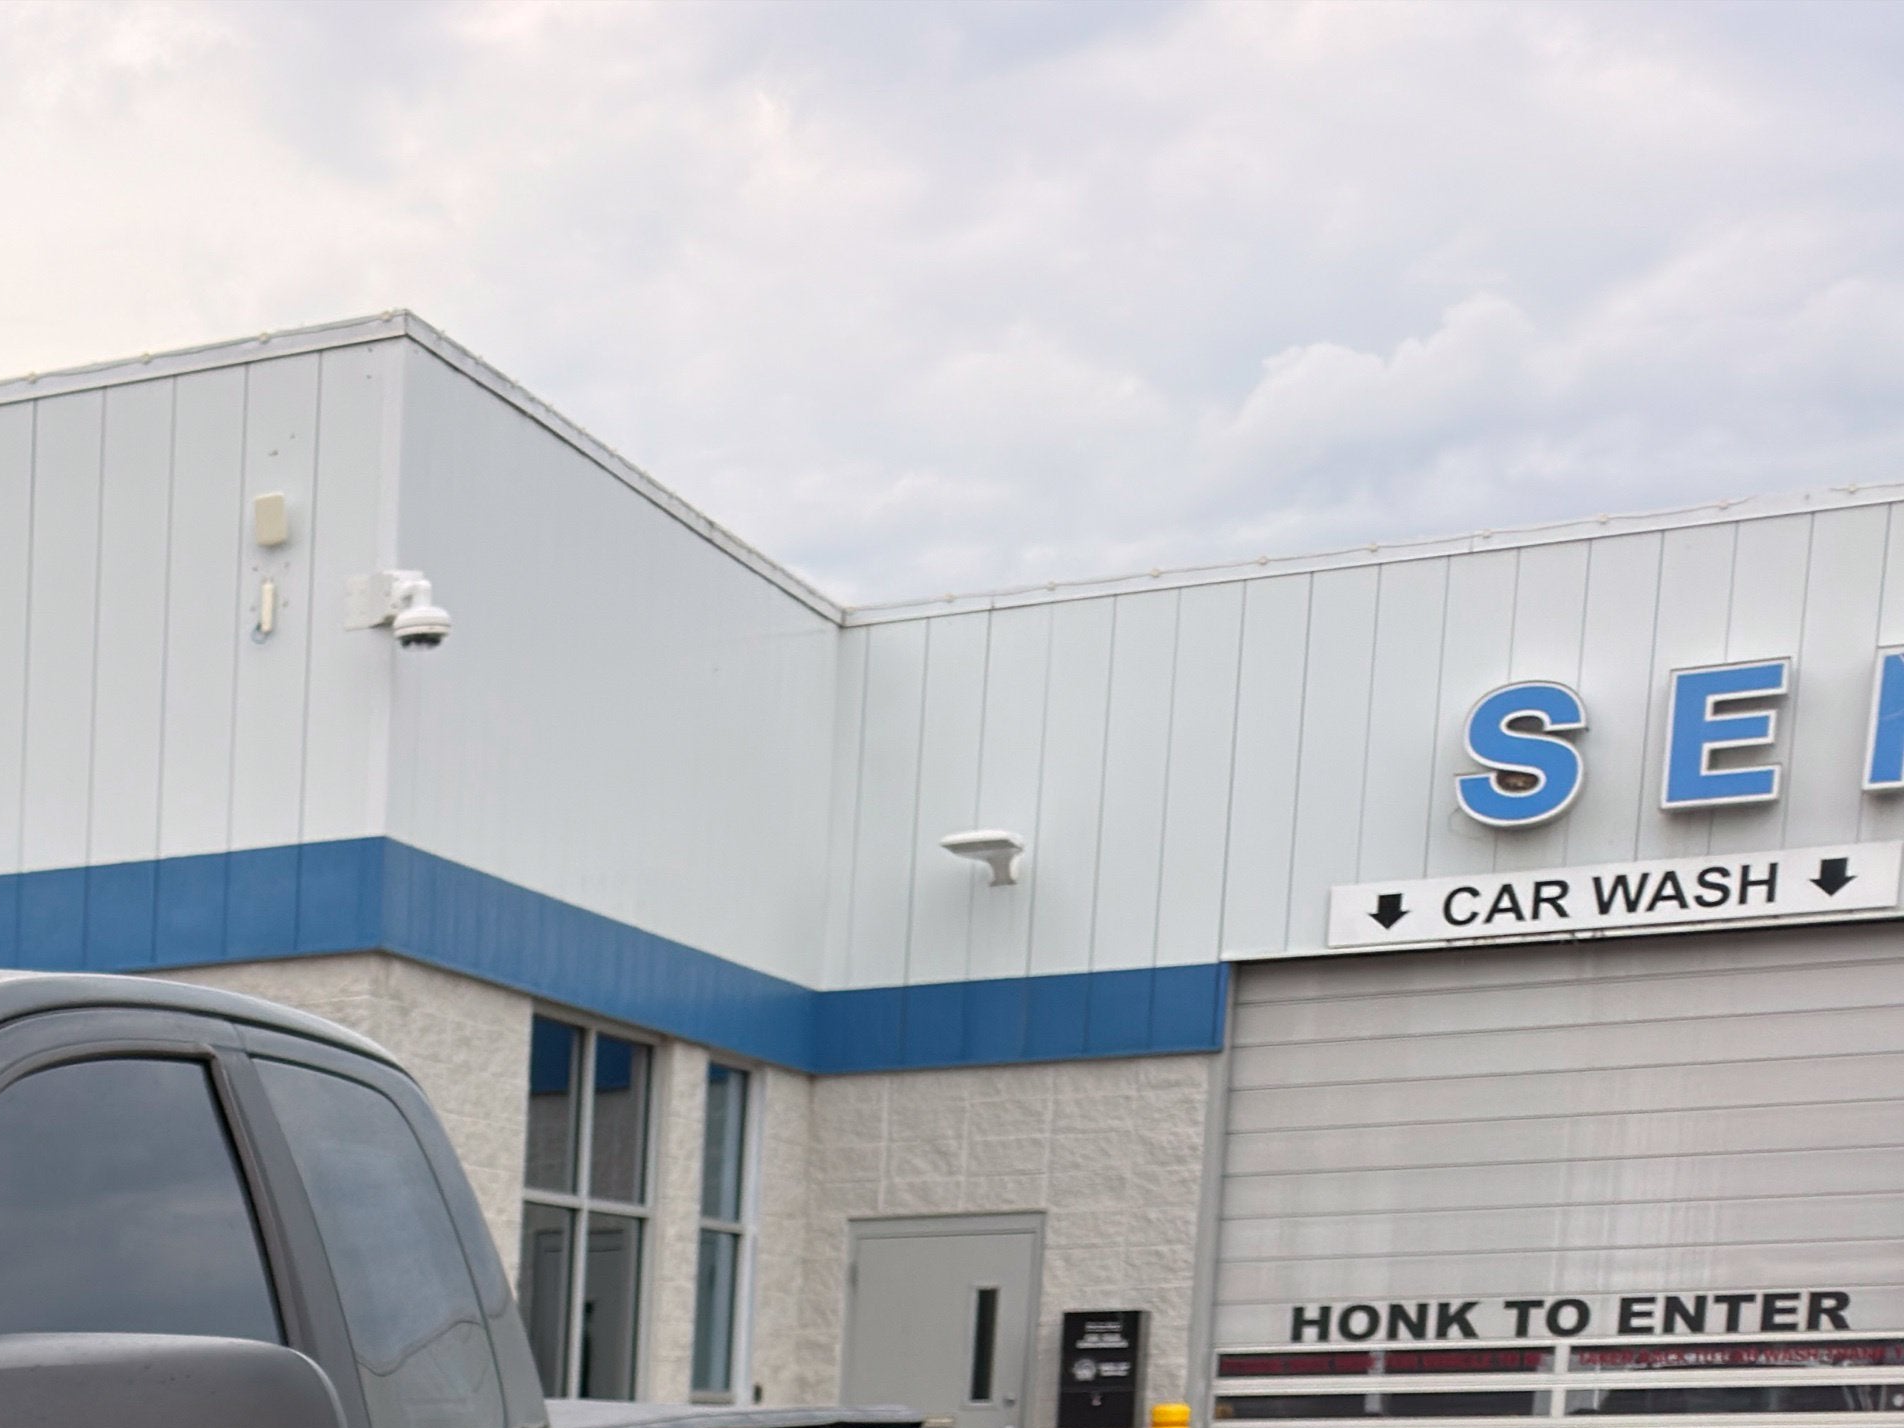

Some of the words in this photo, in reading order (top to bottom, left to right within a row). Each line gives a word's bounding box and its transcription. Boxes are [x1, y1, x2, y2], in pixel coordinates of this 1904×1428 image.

[1442, 878, 1570, 927] CAR
[1593, 862, 1778, 915] WASH
[1289, 1301, 1479, 1343] HONK
[1504, 1298, 1591, 1339] TO
[1617, 1290, 1852, 1335] ENTER
